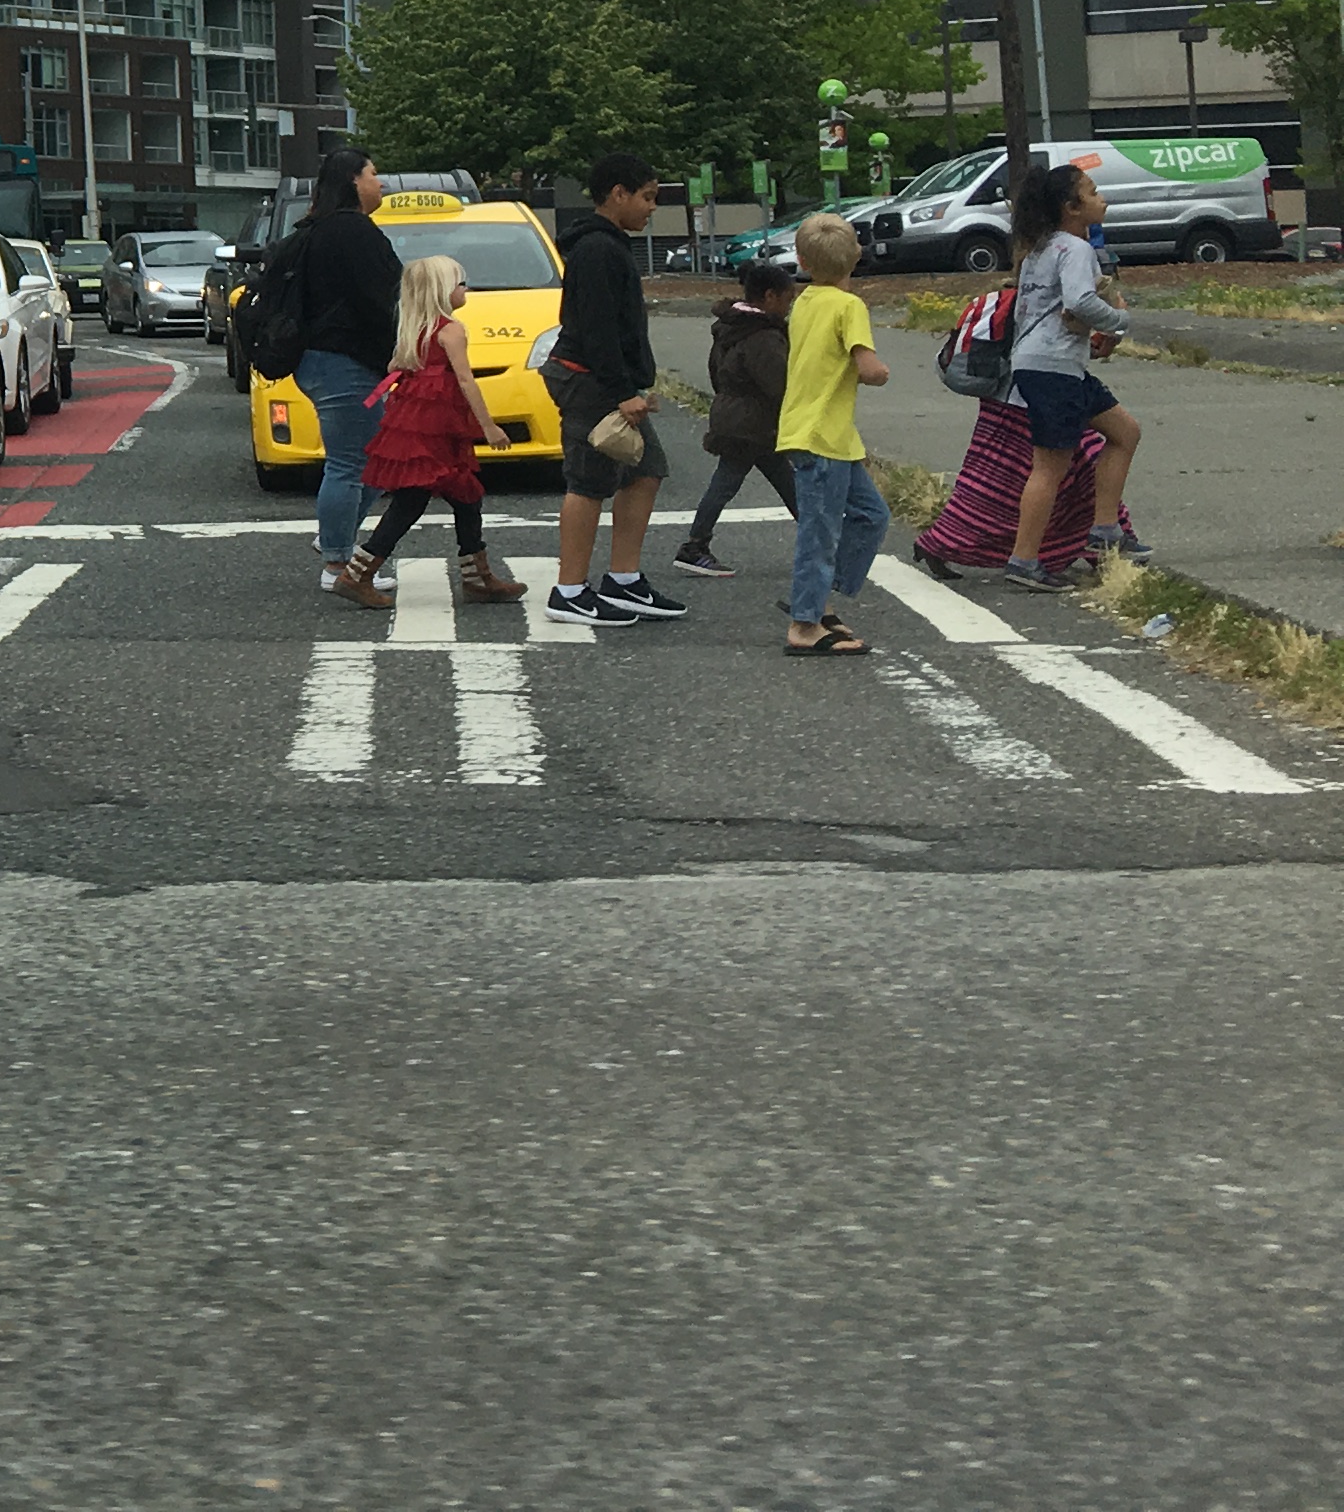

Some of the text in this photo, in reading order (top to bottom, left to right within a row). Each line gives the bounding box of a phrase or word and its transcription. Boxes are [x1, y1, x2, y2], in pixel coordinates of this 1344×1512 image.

[1149, 141, 1240, 173] zipcar
[390, 195, 444, 209] 622-6500
[482, 327, 525, 338] 342
